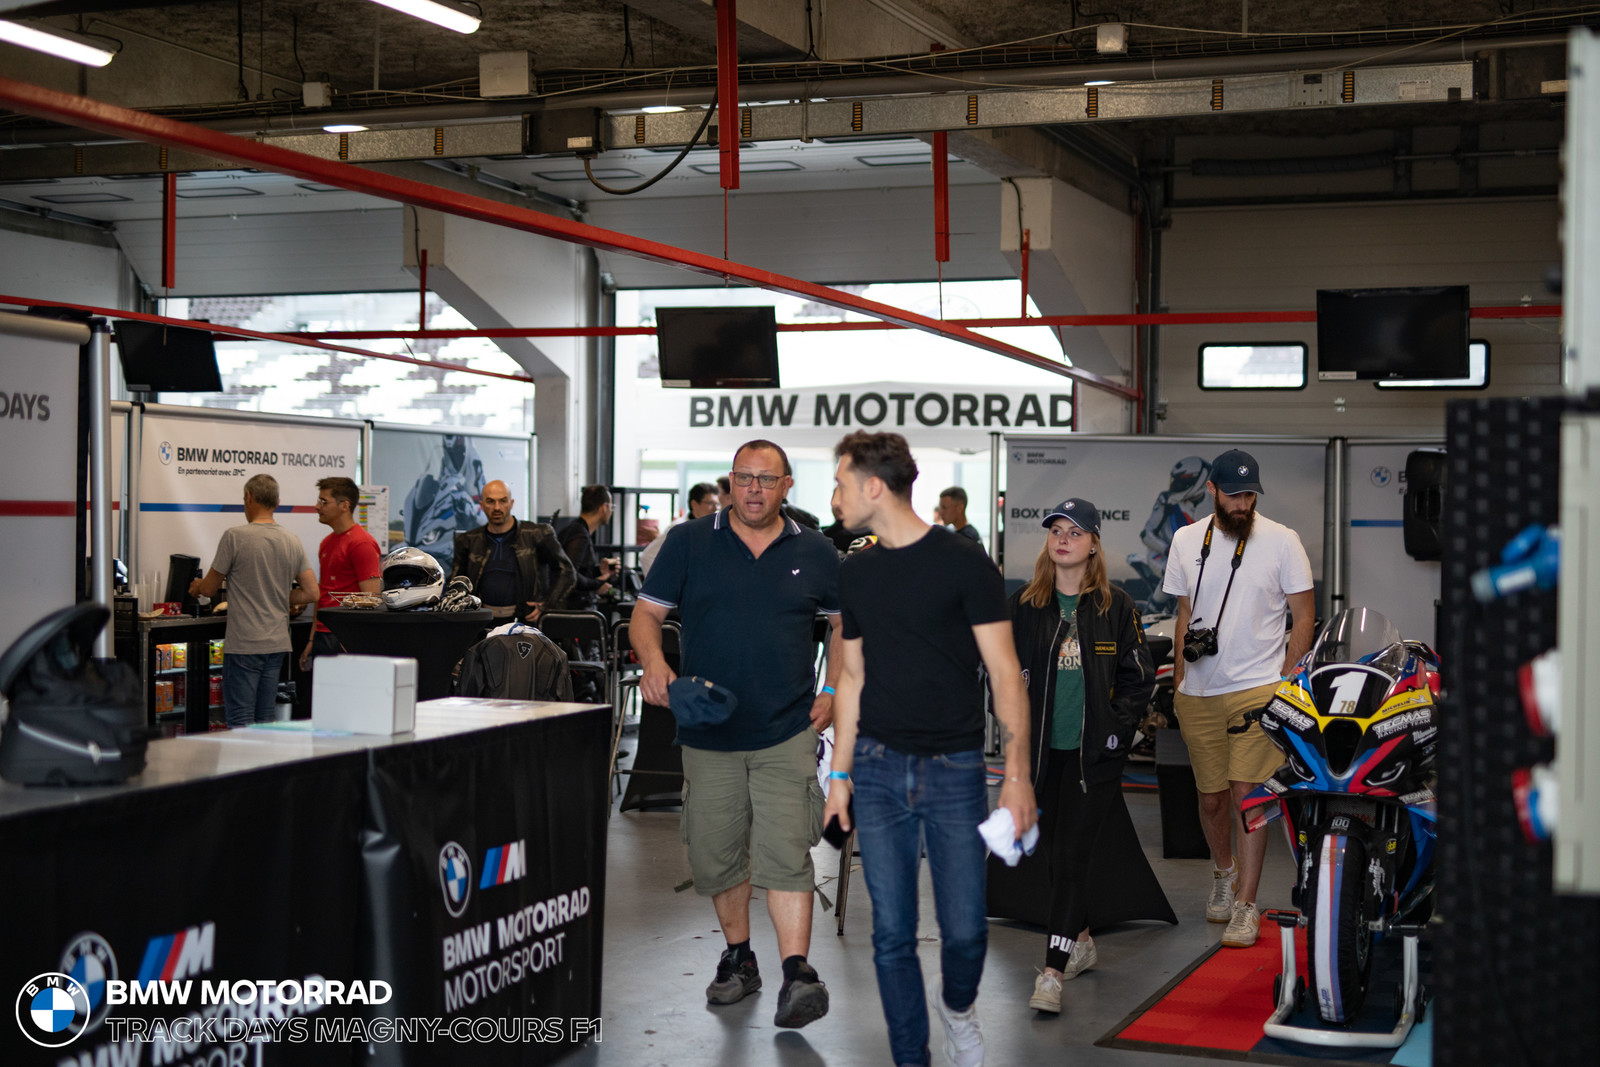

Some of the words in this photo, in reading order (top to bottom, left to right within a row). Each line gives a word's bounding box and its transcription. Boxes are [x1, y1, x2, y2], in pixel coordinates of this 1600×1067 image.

[689, 394, 799, 428] BMW
[813, 392, 1074, 427] MOTORRAD
[176, 447, 209, 462] BMW
[211, 449, 279, 465] MOTORRAD
[281, 452, 317, 467] TRACK
[318, 454, 346, 468] DAYS
[177, 467, 185, 475] En
[185, 467, 218, 477] partenariat
[1011, 507, 1040, 519] BOX
[1328, 671, 1368, 714] 1
[1268, 698, 1316, 729] TECMAS
[1339, 700, 1355, 713] 78
[1382, 700, 1410, 713] MICHELIN
[1372, 708, 1431, 732] TECMAS
[1411, 718, 1431, 727] TEAM
[442, 921, 491, 971] BMW
[497, 886, 590, 950] MOTORRAD
[444, 932, 566, 1014] MOTORSPORT
